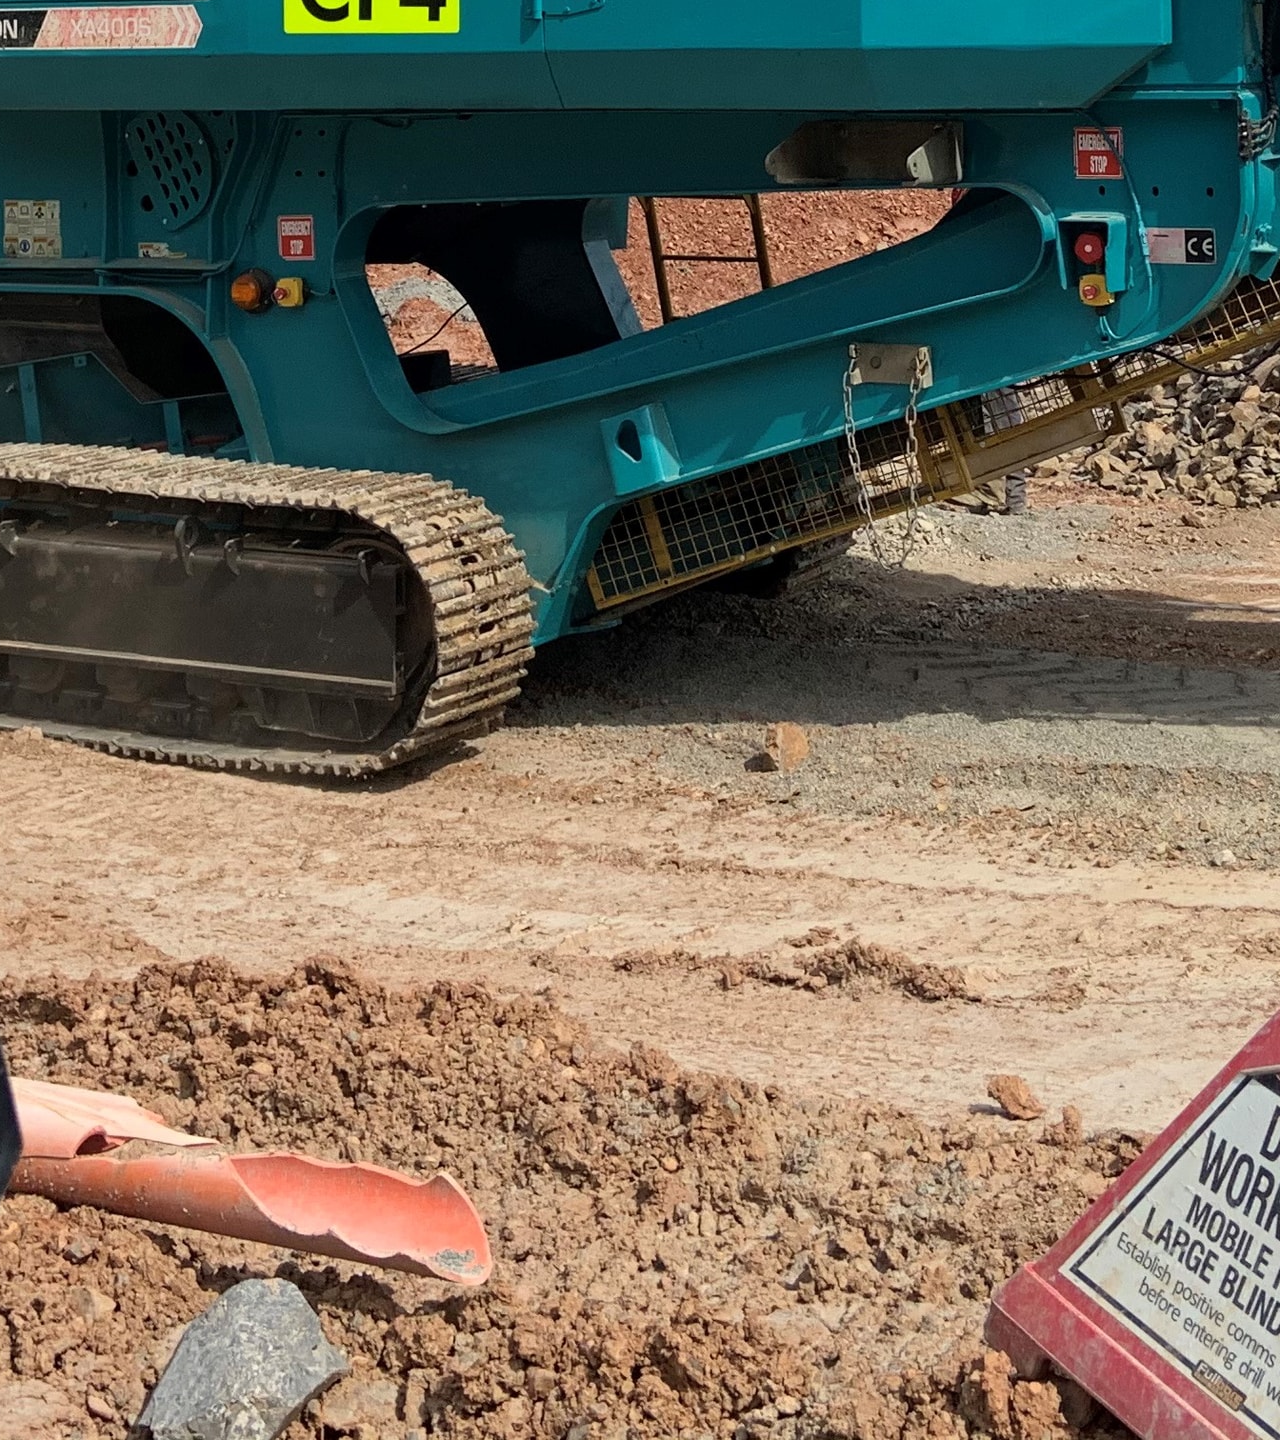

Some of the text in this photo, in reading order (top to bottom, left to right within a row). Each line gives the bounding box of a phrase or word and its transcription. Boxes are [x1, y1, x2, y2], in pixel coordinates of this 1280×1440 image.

[1090, 155, 1108, 173] STOP
[1141, 1207, 1220, 1284] LARGE
[1185, 1194, 1274, 1279] MOBILE
[1117, 1231, 1173, 1288] Establish
[1172, 1277, 1225, 1328] positive
[1227, 1319, 1277, 1368] comms
[1138, 1276, 1181, 1322] before
[1183, 1315, 1238, 1370] entering
[1238, 1360, 1267, 1390] drill
